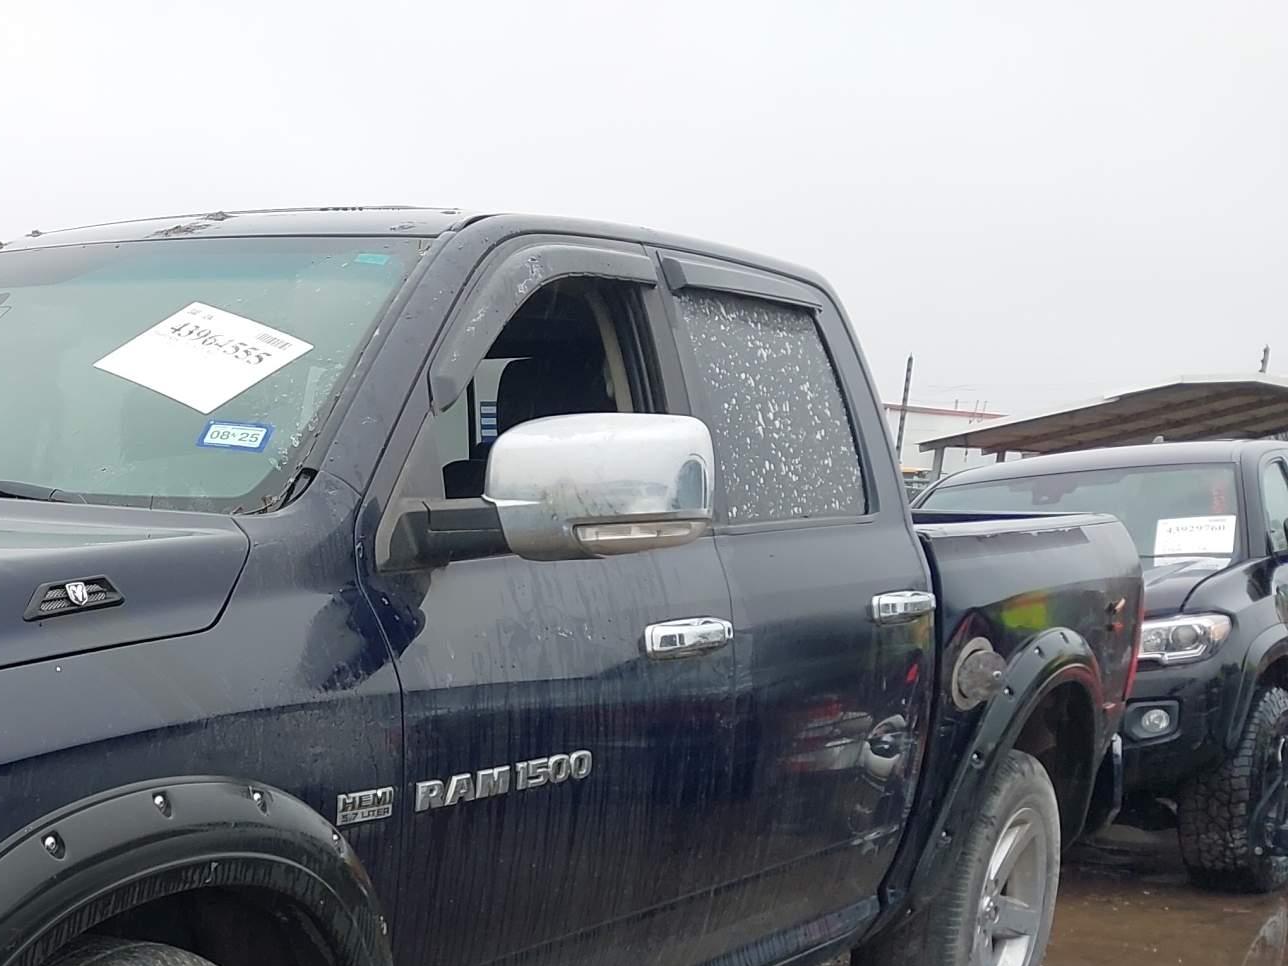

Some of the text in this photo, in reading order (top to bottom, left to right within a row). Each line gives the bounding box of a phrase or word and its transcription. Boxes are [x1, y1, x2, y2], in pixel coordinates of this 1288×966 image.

[170, 322, 273, 366] 43964555
[415, 750, 593, 813] RAM 1500
[337, 786, 394, 813] HEMI
[361, 806, 390, 819] LITER
